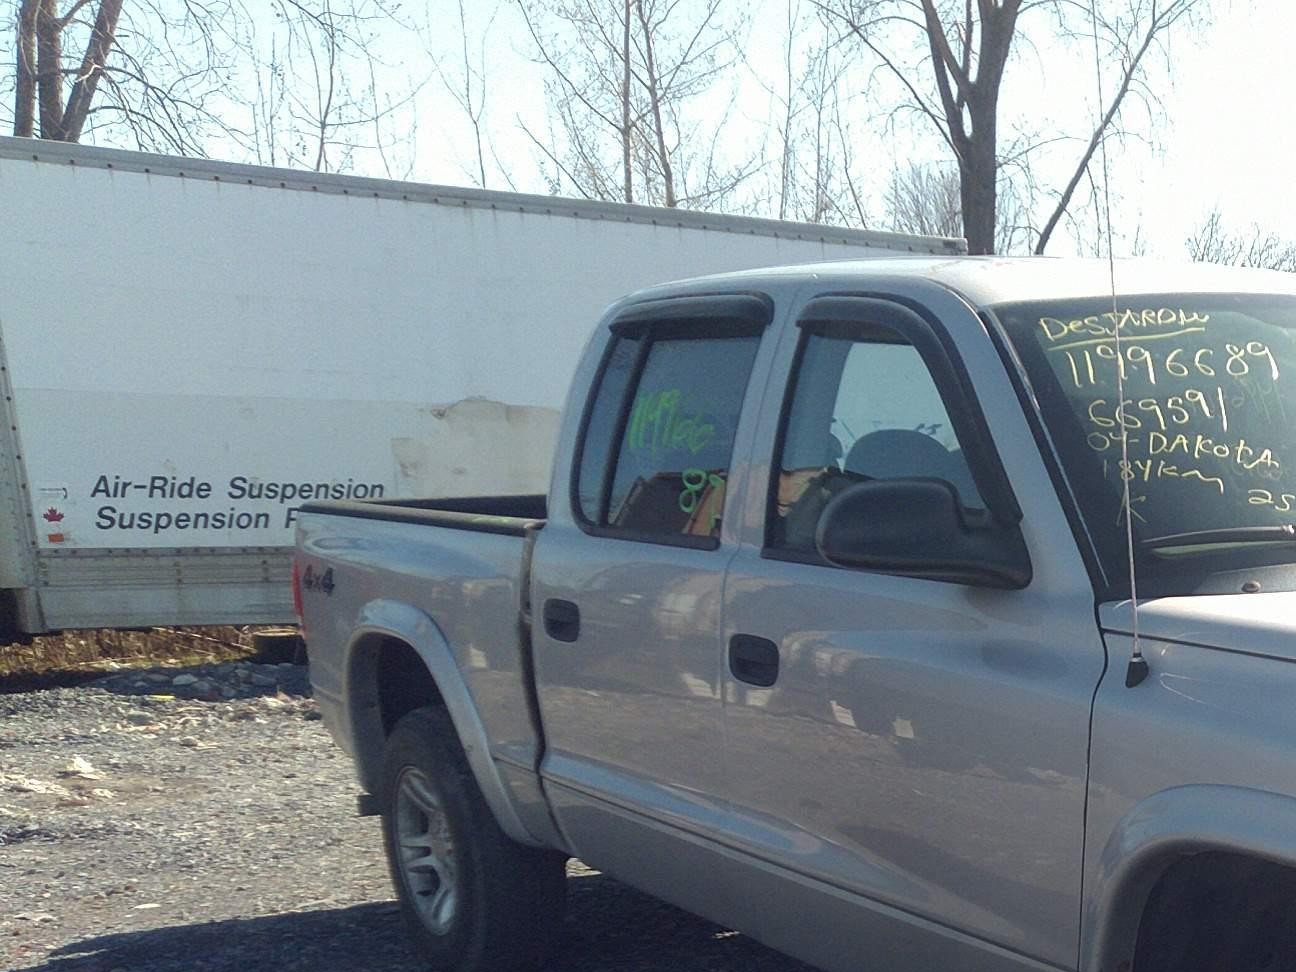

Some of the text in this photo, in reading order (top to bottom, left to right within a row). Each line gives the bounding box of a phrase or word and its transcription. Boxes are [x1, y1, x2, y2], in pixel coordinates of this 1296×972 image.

[1065, 341, 1280, 388] 11996689
[1088, 386, 1229, 433] 669591
[90, 475, 385, 504] Air-Ride Suspension
[95, 505, 270, 535] Suspension
